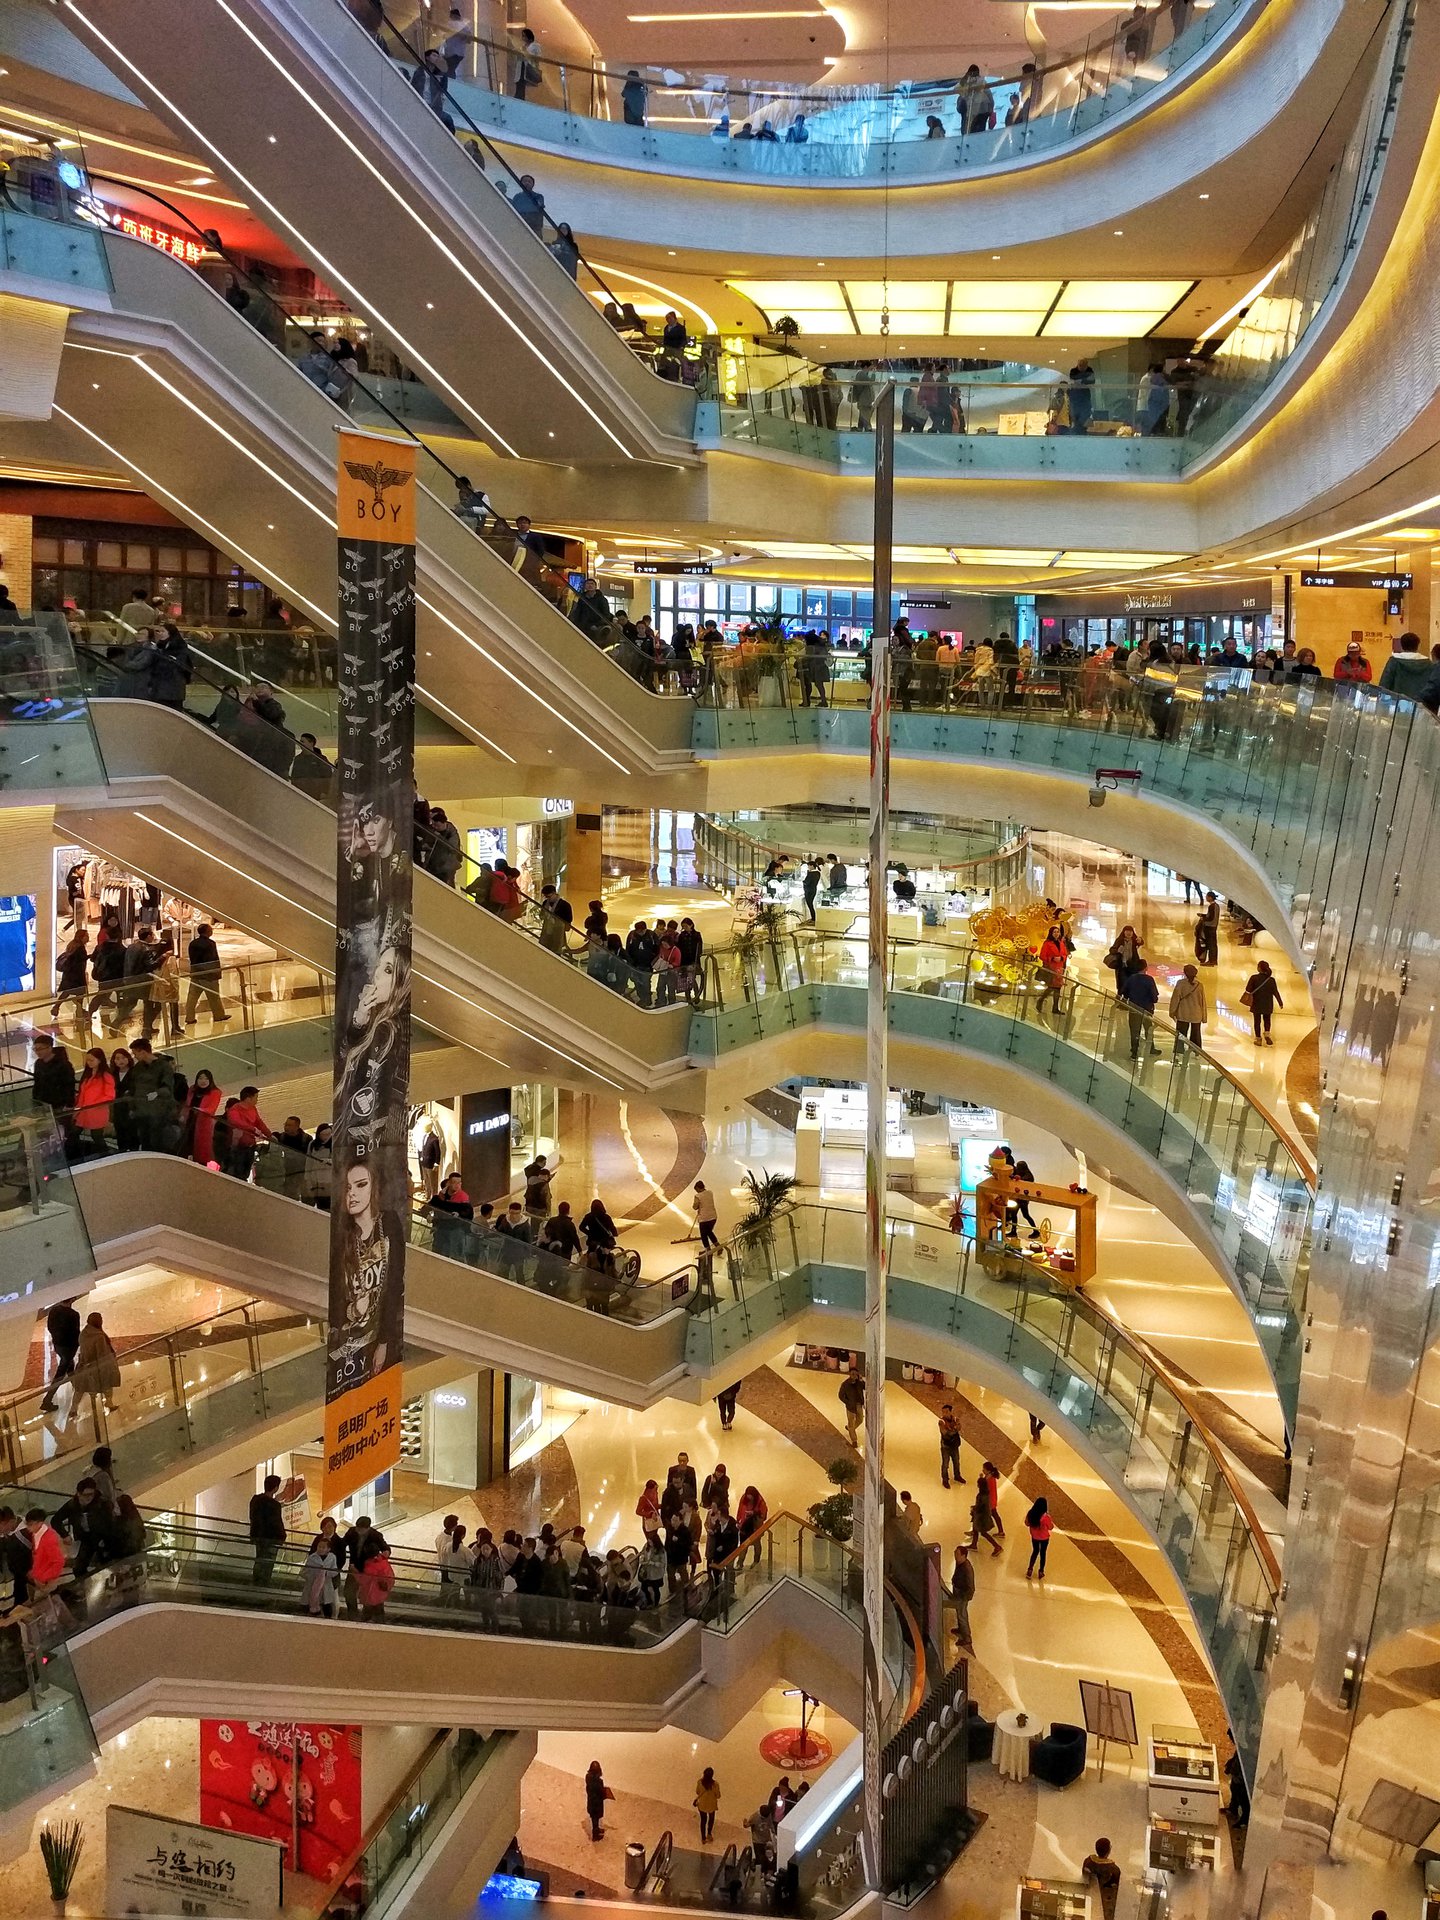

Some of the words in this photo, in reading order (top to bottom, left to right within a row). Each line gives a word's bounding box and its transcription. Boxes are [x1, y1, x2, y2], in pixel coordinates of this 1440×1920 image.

[123, 217, 206, 263] 西班牙海鲜
[357, 499, 401, 523] BOY
[391, 600, 408, 616] BOY
[391, 700, 407, 716] BOY
[485, 1113, 510, 1131] DAVID
[356, 1138, 380, 1156] BOY
[336, 1356, 366, 1383] BOY
[436, 1393, 467, 1406] ecco
[337, 1396, 389, 1444] 昆明广场
[146, 1846, 236, 1881] 与您相约
